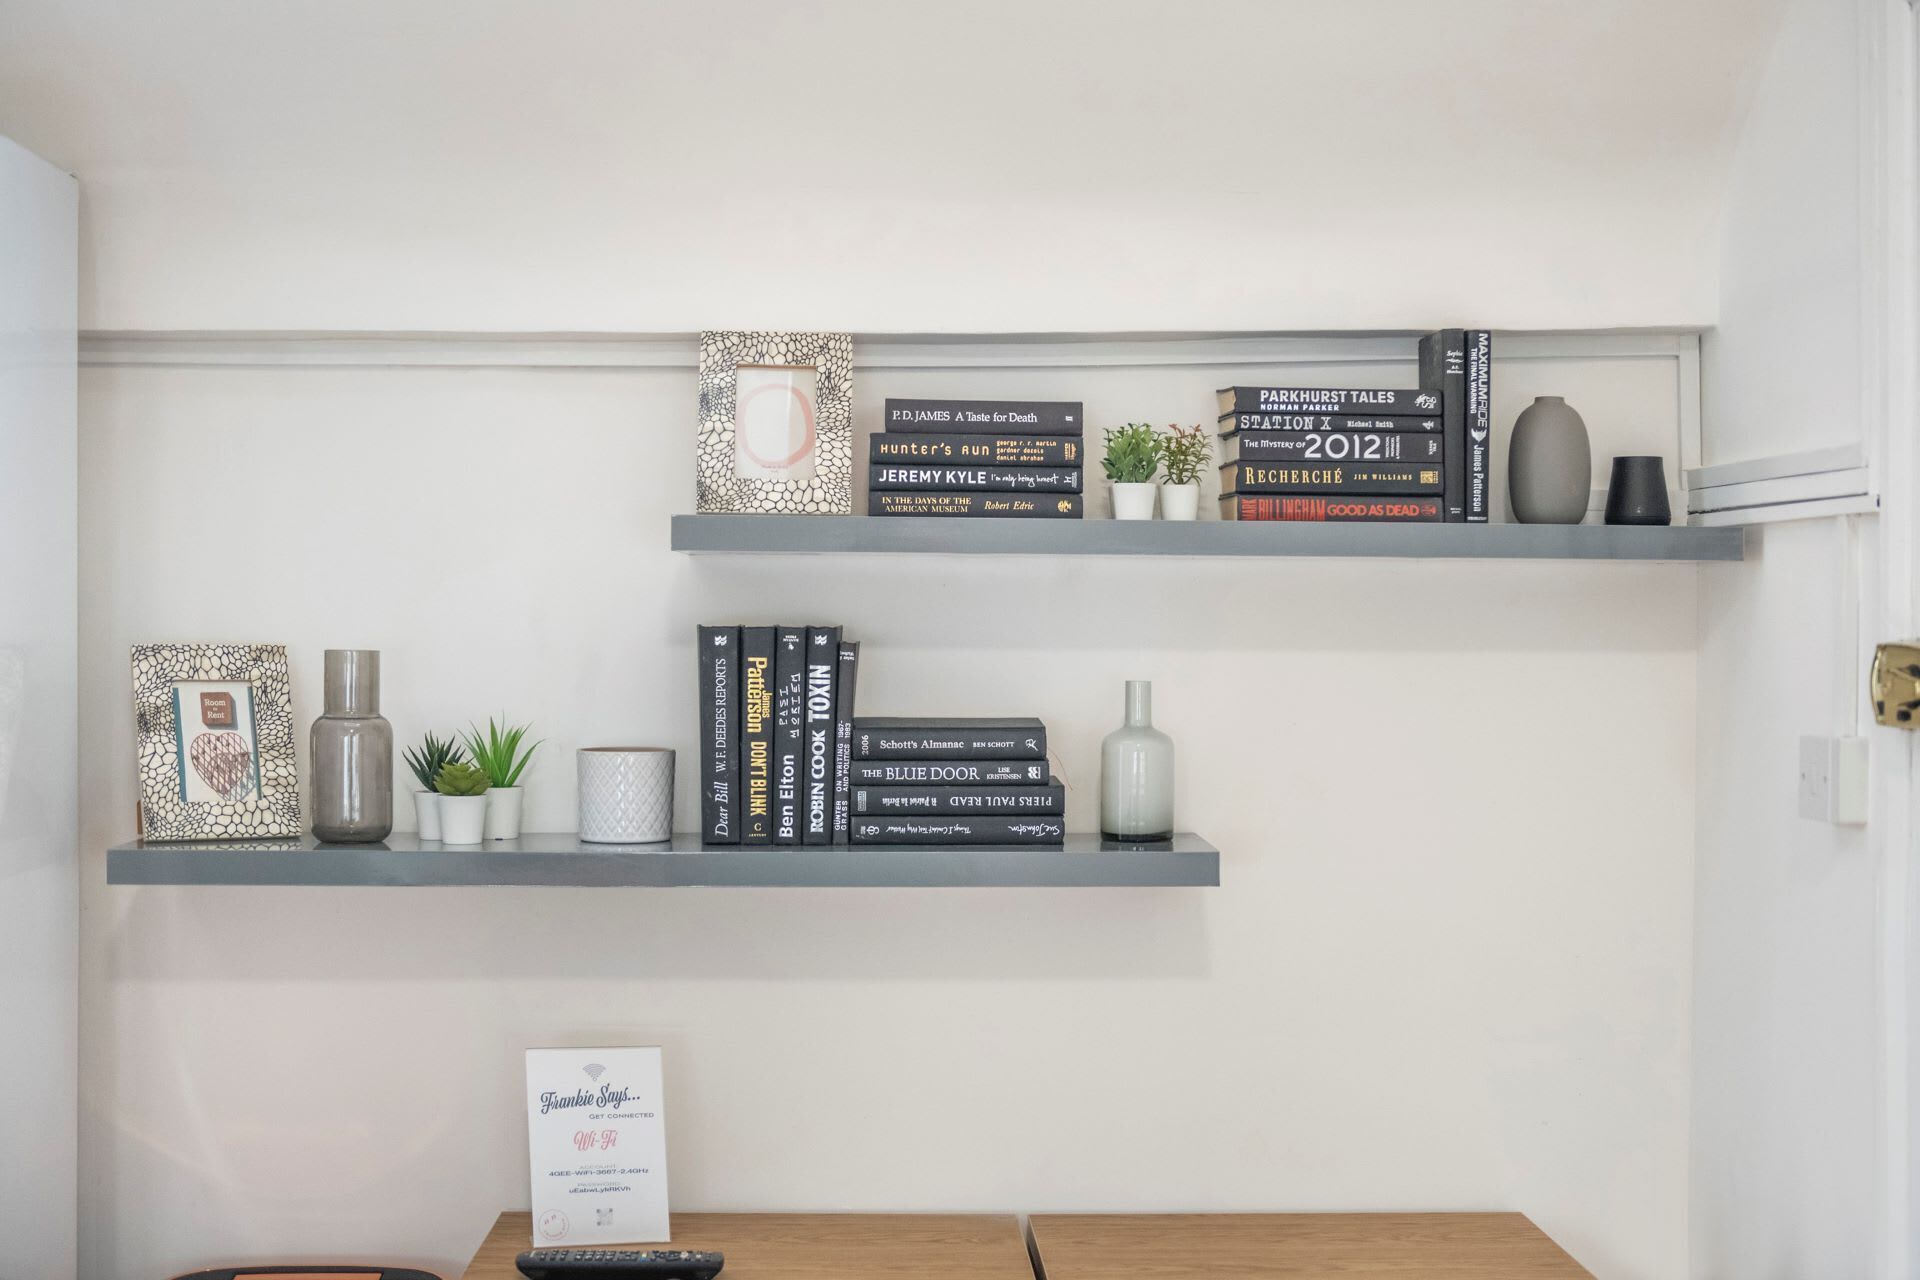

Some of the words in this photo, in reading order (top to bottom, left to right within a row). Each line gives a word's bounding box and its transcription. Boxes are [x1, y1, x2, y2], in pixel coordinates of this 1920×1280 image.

[1260, 390, 1347, 403] PARKHURST
[1350, 391, 1395, 403] TALES
[914, 411, 950, 422] JAMES
[956, 412, 964, 421] A
[966, 412, 990, 422] Taste
[993, 412, 1007, 422] for
[1009, 413, 1037, 422] Death
[1240, 416, 1314, 430] STATION
[1320, 417, 1332, 430] X
[1305, 434, 1380, 458] 2012
[1474, 445, 1484, 472] James
[879, 470, 942, 483] JEREMY
[946, 471, 986, 484] KYLE
[1002, 474, 1016, 486] only
[1017, 474, 1036, 487] being
[1036, 474, 1059, 484] honest
[1473, 473, 1482, 511] Patterson
[984, 501, 1010, 510] Robert
[1013, 501, 1035, 510] Edric
[1258, 499, 1326, 521] BILLINGHAM
[1327, 504, 1367, 516] GOOD
[1369, 504, 1383, 516] AS
[1386, 505, 1419, 516] DEAD
[716, 658, 726, 708] REPORTS
[747, 657, 767, 732] Patterson
[808, 665, 831, 722] TOXIN
[762, 691, 772, 718] James
[716, 709, 726, 748] DEEDES
[811, 730, 826, 779] COOK
[880, 740, 918, 749] Schott's
[921, 740, 964, 749] Almanac
[716, 758, 726, 772] W.
[751, 741, 767, 776] DON'T
[779, 754, 794, 799] Elton
[886, 768, 927, 779] BLUE
[930, 767, 980, 780] DOOR
[715, 781, 728, 804] Bill
[750, 778, 766, 816] BLINK
[836, 781, 842, 792] ON
[809, 783, 824, 832] ROBIN
[986, 797, 1015, 805] PAUL
[1019, 797, 1052, 805] PIERS
[715, 804, 729, 836] Dear
[779, 805, 793, 837] Ben
[540, 1089, 594, 1114] Frankie
[596, 1083, 640, 1109] Says...
[574, 1130, 618, 1151] Wi-Fi
